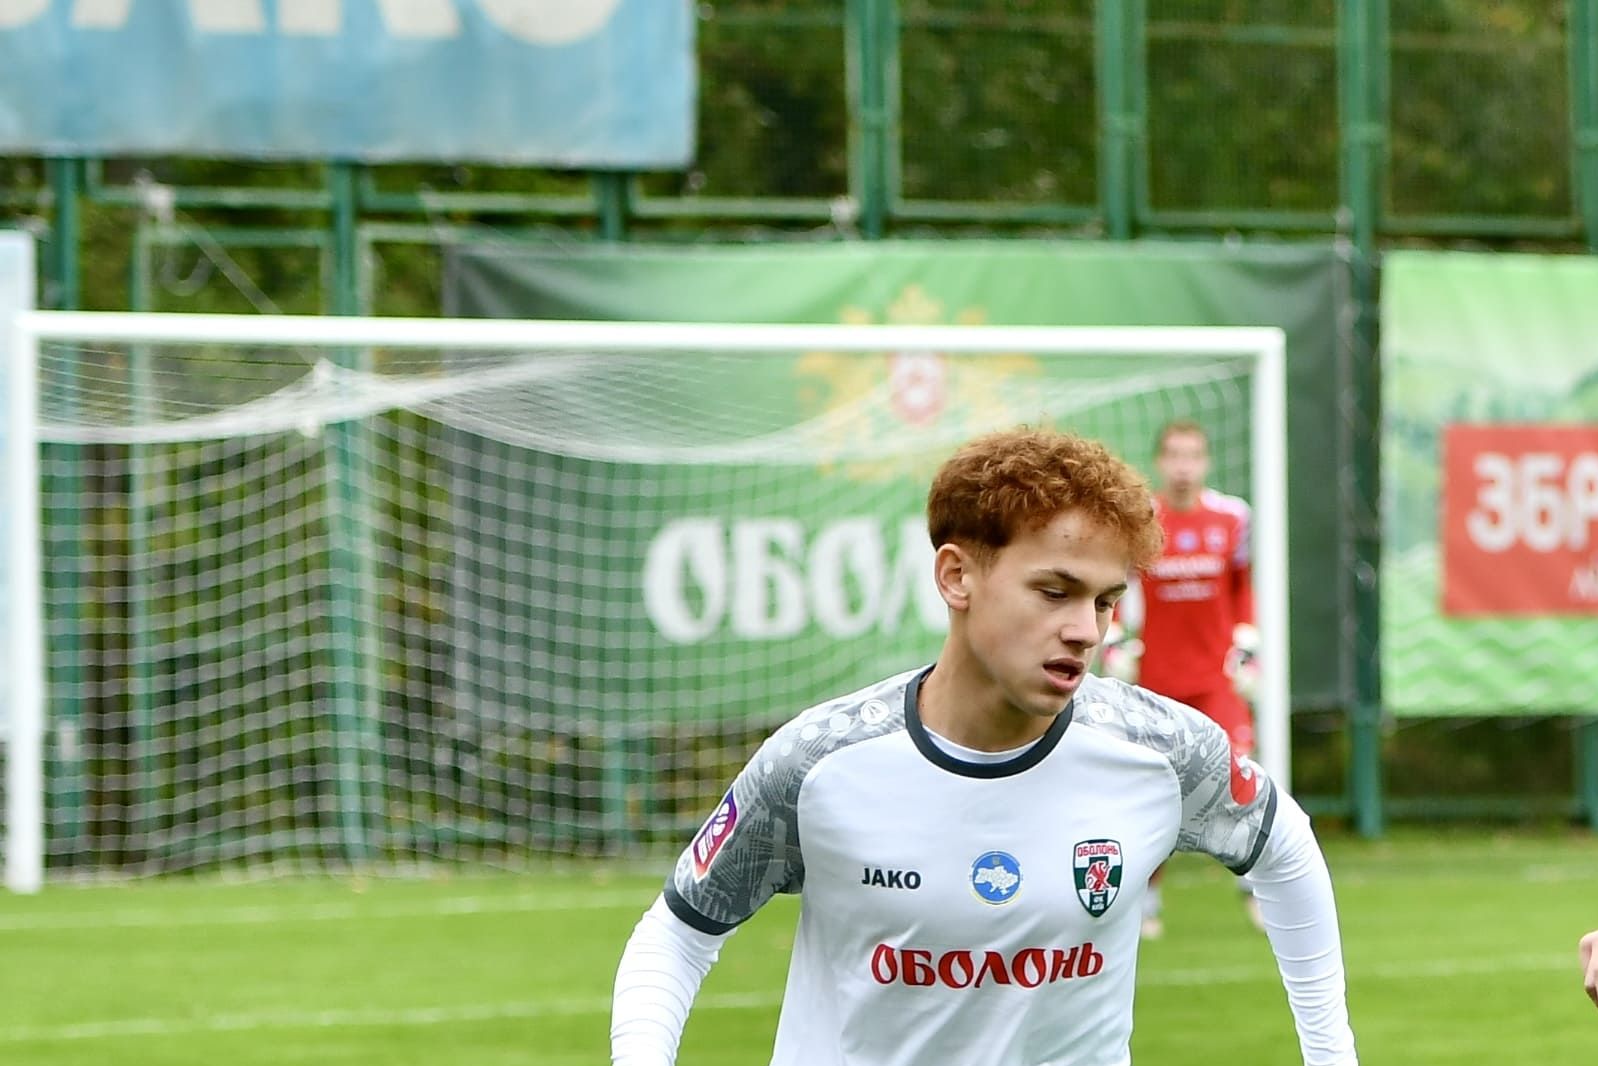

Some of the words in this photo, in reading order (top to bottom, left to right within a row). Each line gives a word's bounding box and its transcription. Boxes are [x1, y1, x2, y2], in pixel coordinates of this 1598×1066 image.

[643, 515, 952, 644] ОБОЛ
[861, 866, 921, 890] JAKO
[870, 942, 1104, 989] ОБОЛОНЬ
